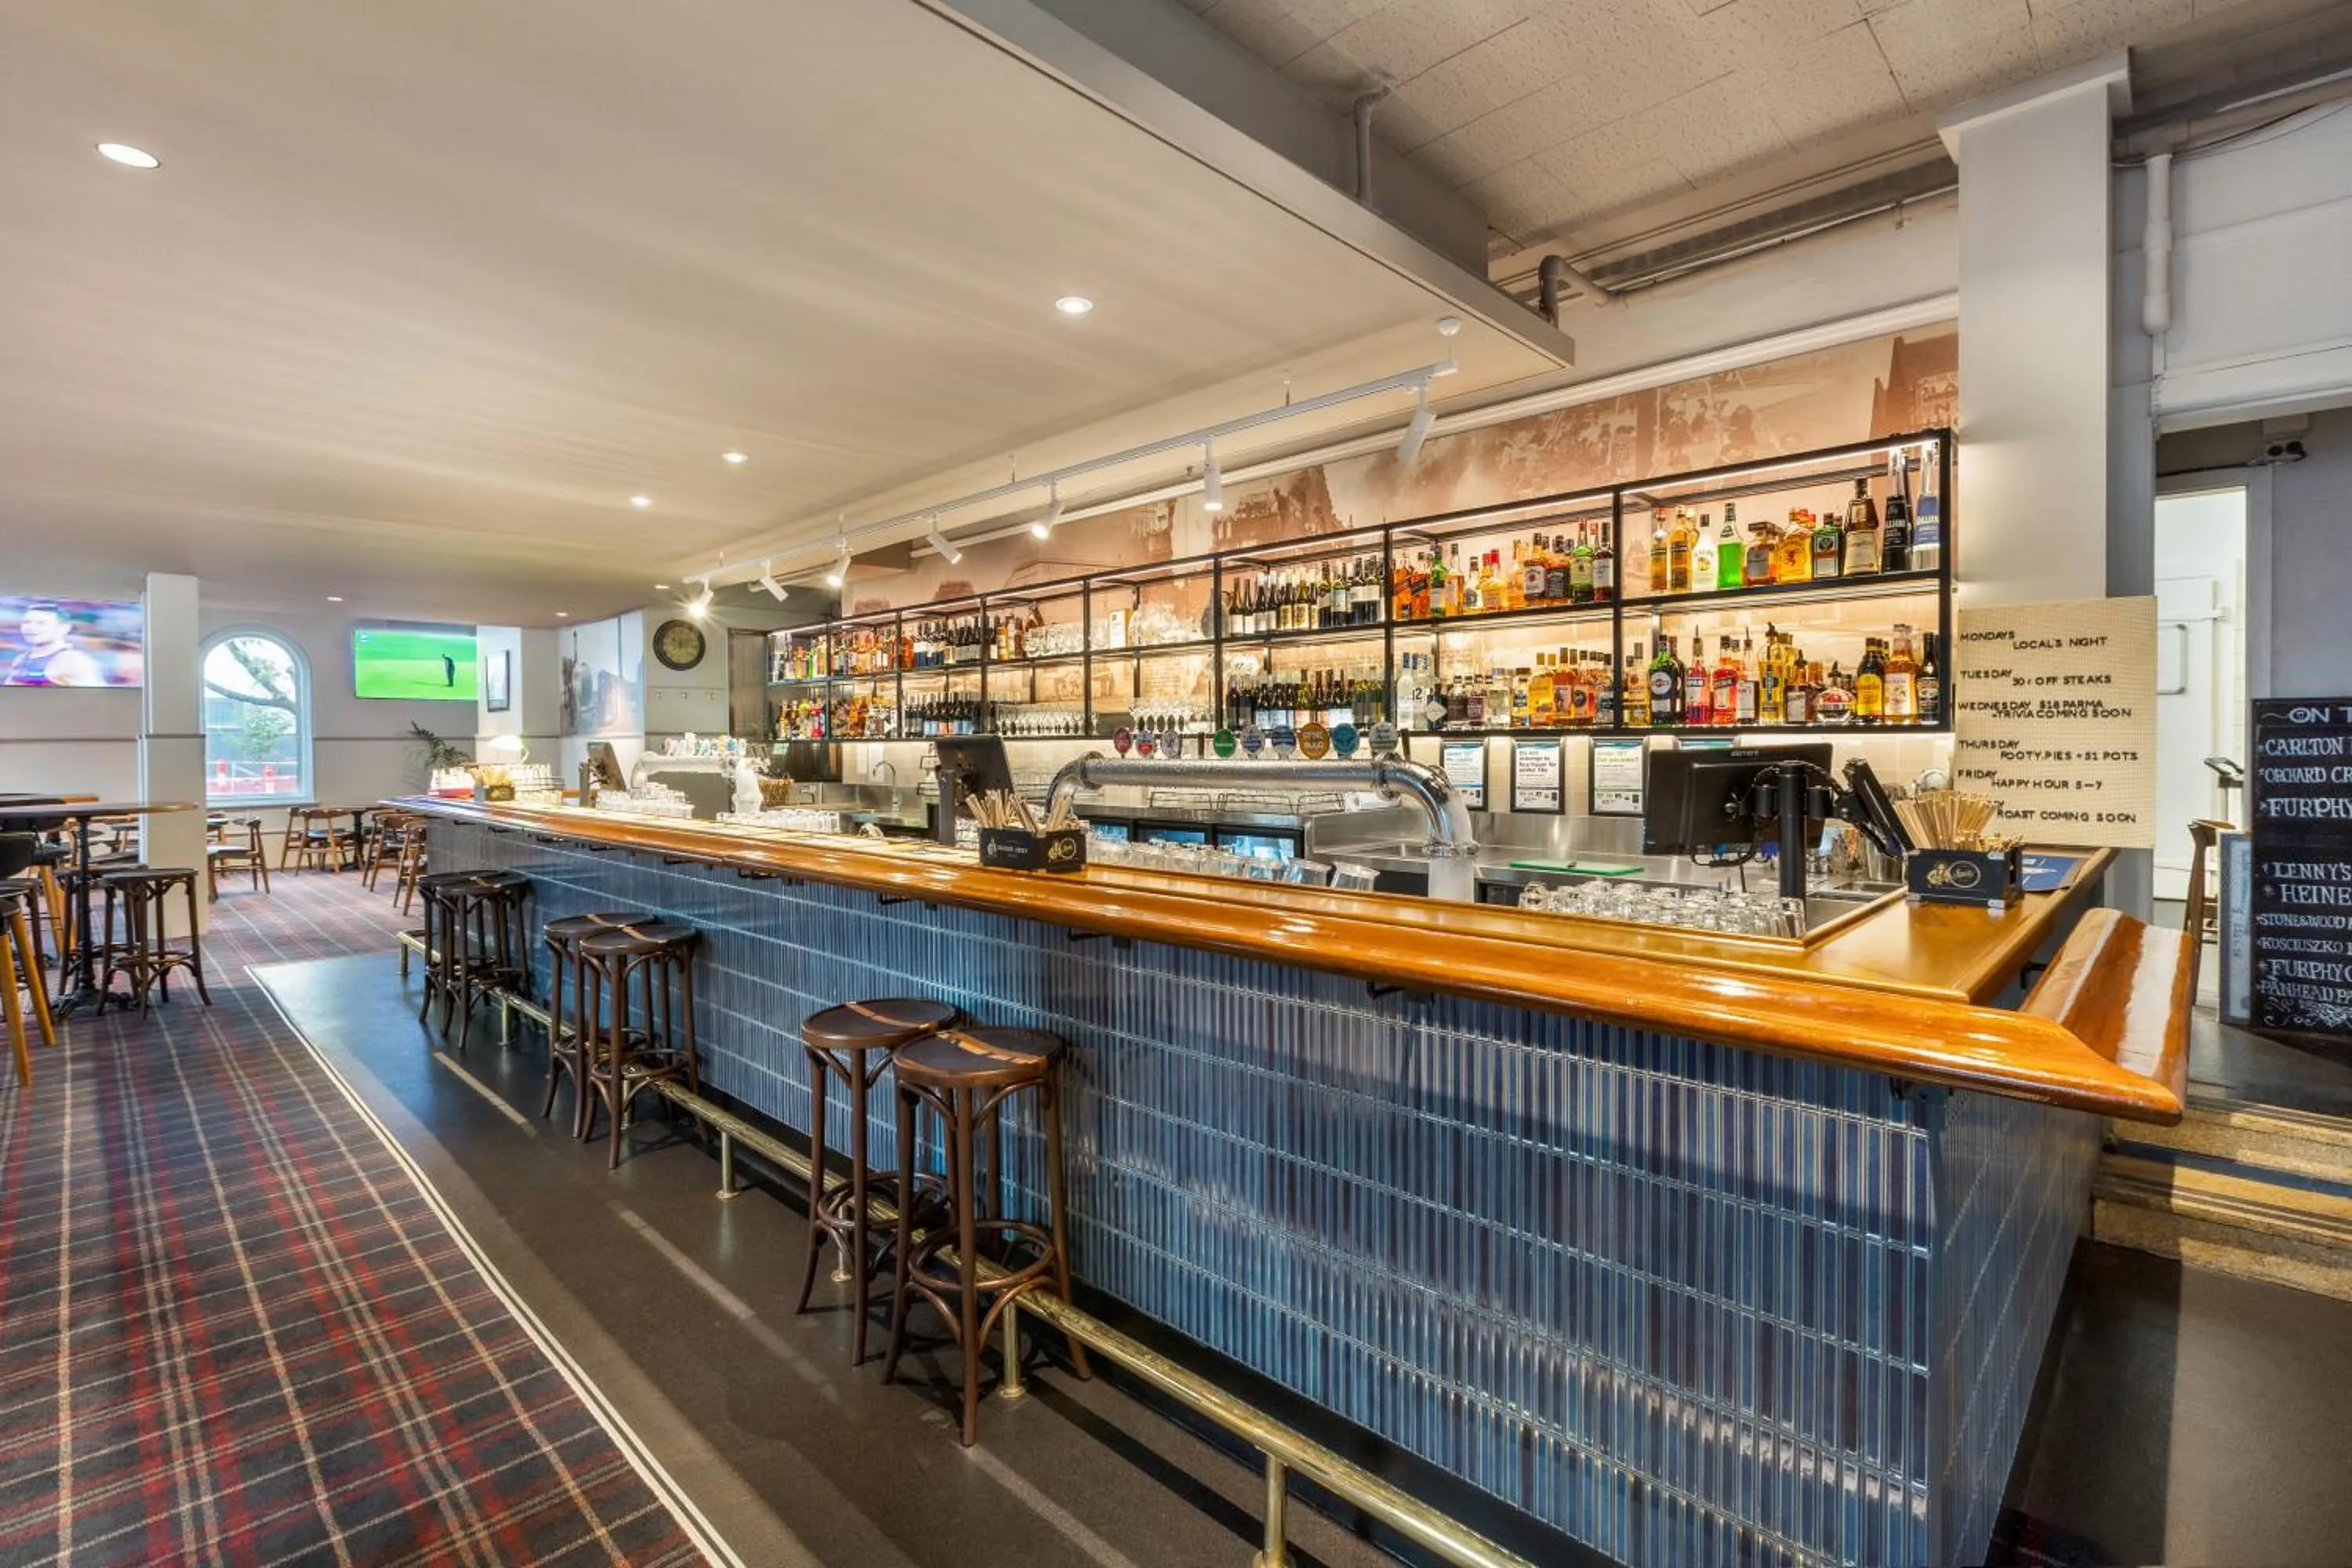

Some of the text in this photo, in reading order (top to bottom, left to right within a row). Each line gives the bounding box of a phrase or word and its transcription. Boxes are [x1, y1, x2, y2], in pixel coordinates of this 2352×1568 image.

[1959, 631, 2015, 641] MONDAYS
[2013, 637, 2108, 650] LOCAL'S NIGHT
[1960, 670, 2013, 679] TUESDAY
[2034, 677, 2059, 685] OFF
[2063, 674, 2112, 684] STEAKS
[1958, 700, 2031, 710] WEDNESDAY
[2063, 700, 2103, 709] PARMA
[2036, 709, 2088, 719] COMING
[2092, 708, 2132, 718] SOON
[2288, 706, 2330, 724] ON
[1958, 740, 2020, 750] THURSDAY
[2265, 736, 2344, 756] CARLTON
[2103, 751, 2139, 761] POTS
[1958, 769, 1997, 779] FRIDAY
[2264, 767, 2326, 783] ORCHARD
[1991, 779, 2030, 789] HAPPY
[2033, 779, 2069, 789] HOUR
[2266, 797, 2352, 819] FURPHY
[1997, 809, 2136, 823] ROAST COMING SOON
[2272, 862, 2352, 880] LENNY'S
[2280, 884, 2352, 906] HEINE
[2267, 959, 2343, 982] FURPHY
[2260, 979, 2334, 1002] PANHEAD
